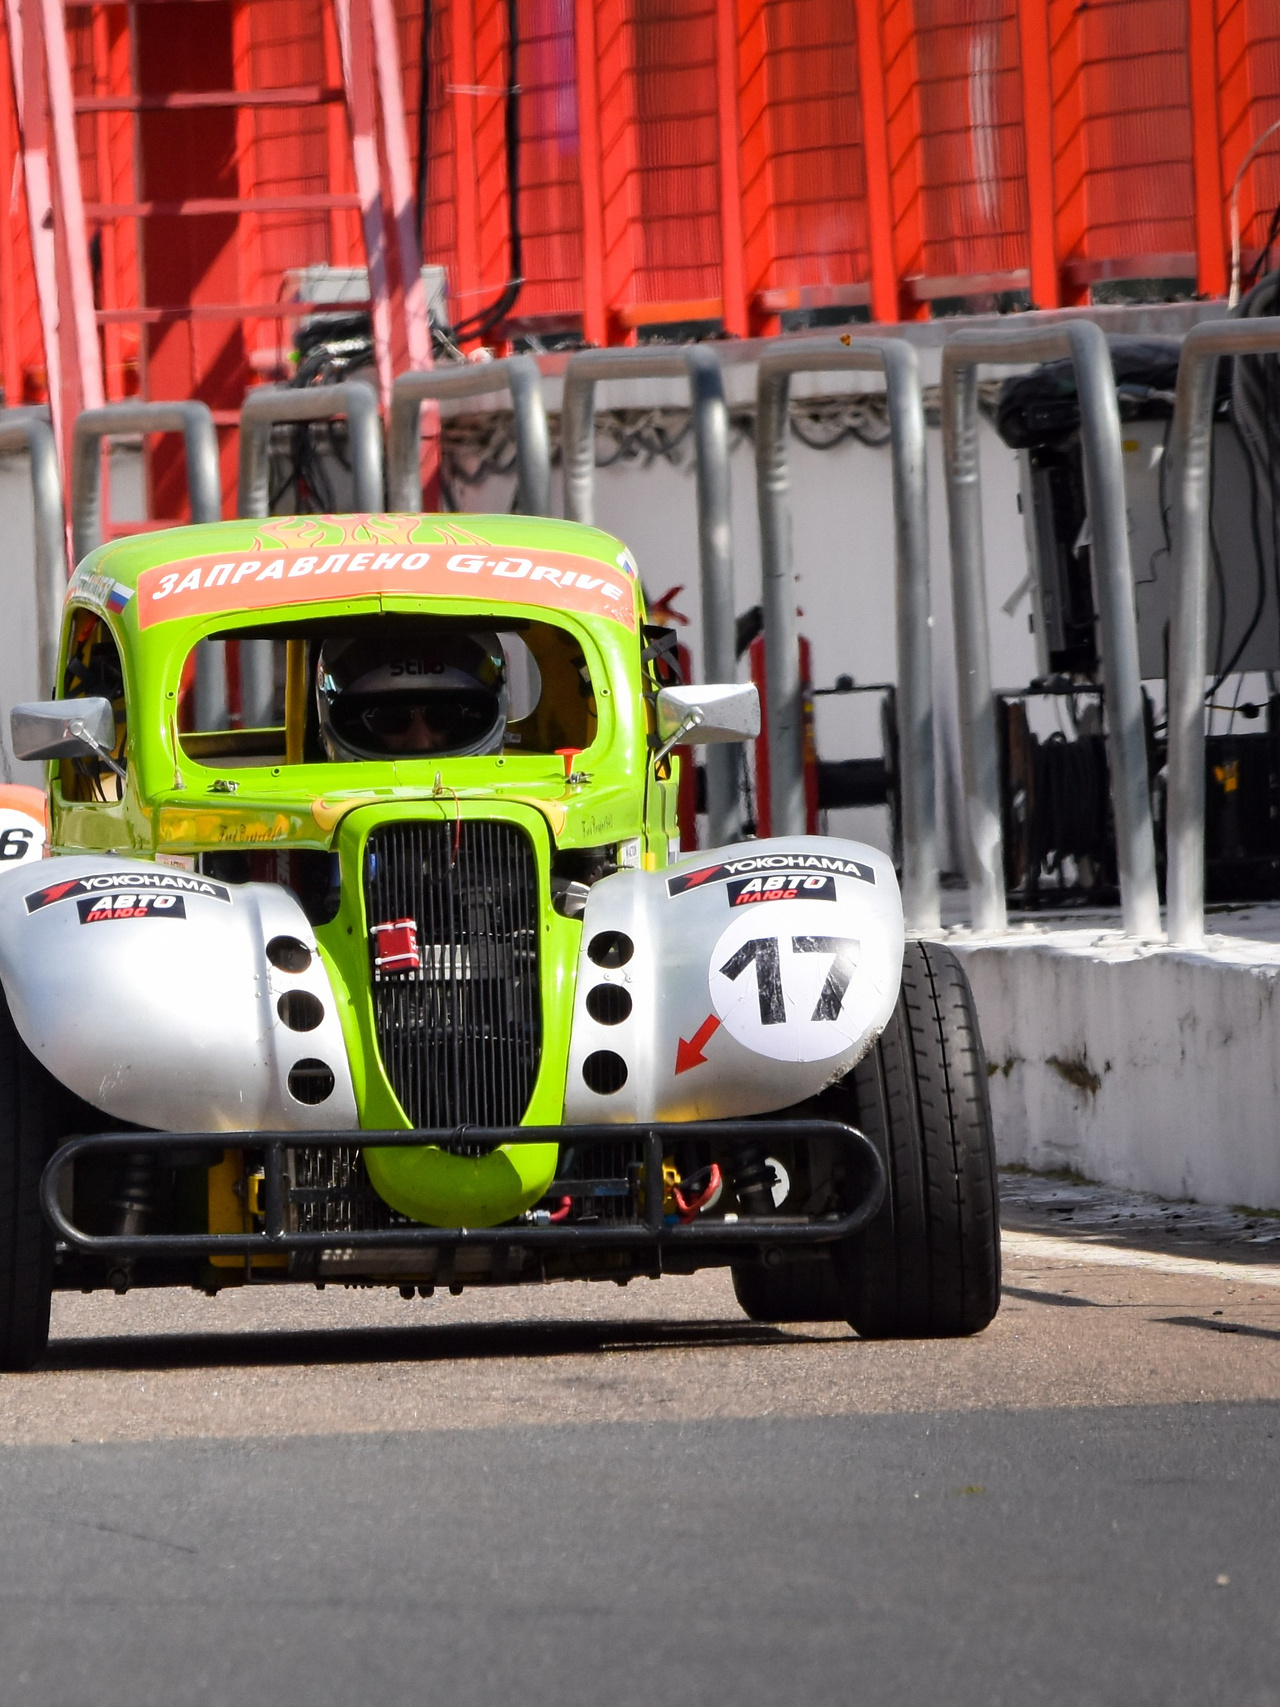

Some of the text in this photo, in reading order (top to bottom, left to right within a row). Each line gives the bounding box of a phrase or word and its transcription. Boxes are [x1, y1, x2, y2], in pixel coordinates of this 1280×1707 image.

[151, 552, 431, 601] ЗАПРАВЛЕНО
[723, 855, 862, 877] YOKOHAMA
[79, 874, 217, 896] YOKOHAMA
[739, 875, 828, 895] АВТО
[90, 894, 178, 912] АВТО
[734, 888, 799, 905] ПЛЮС
[85, 906, 149, 923] ПЛЮС
[718, 934, 862, 1026] 17
